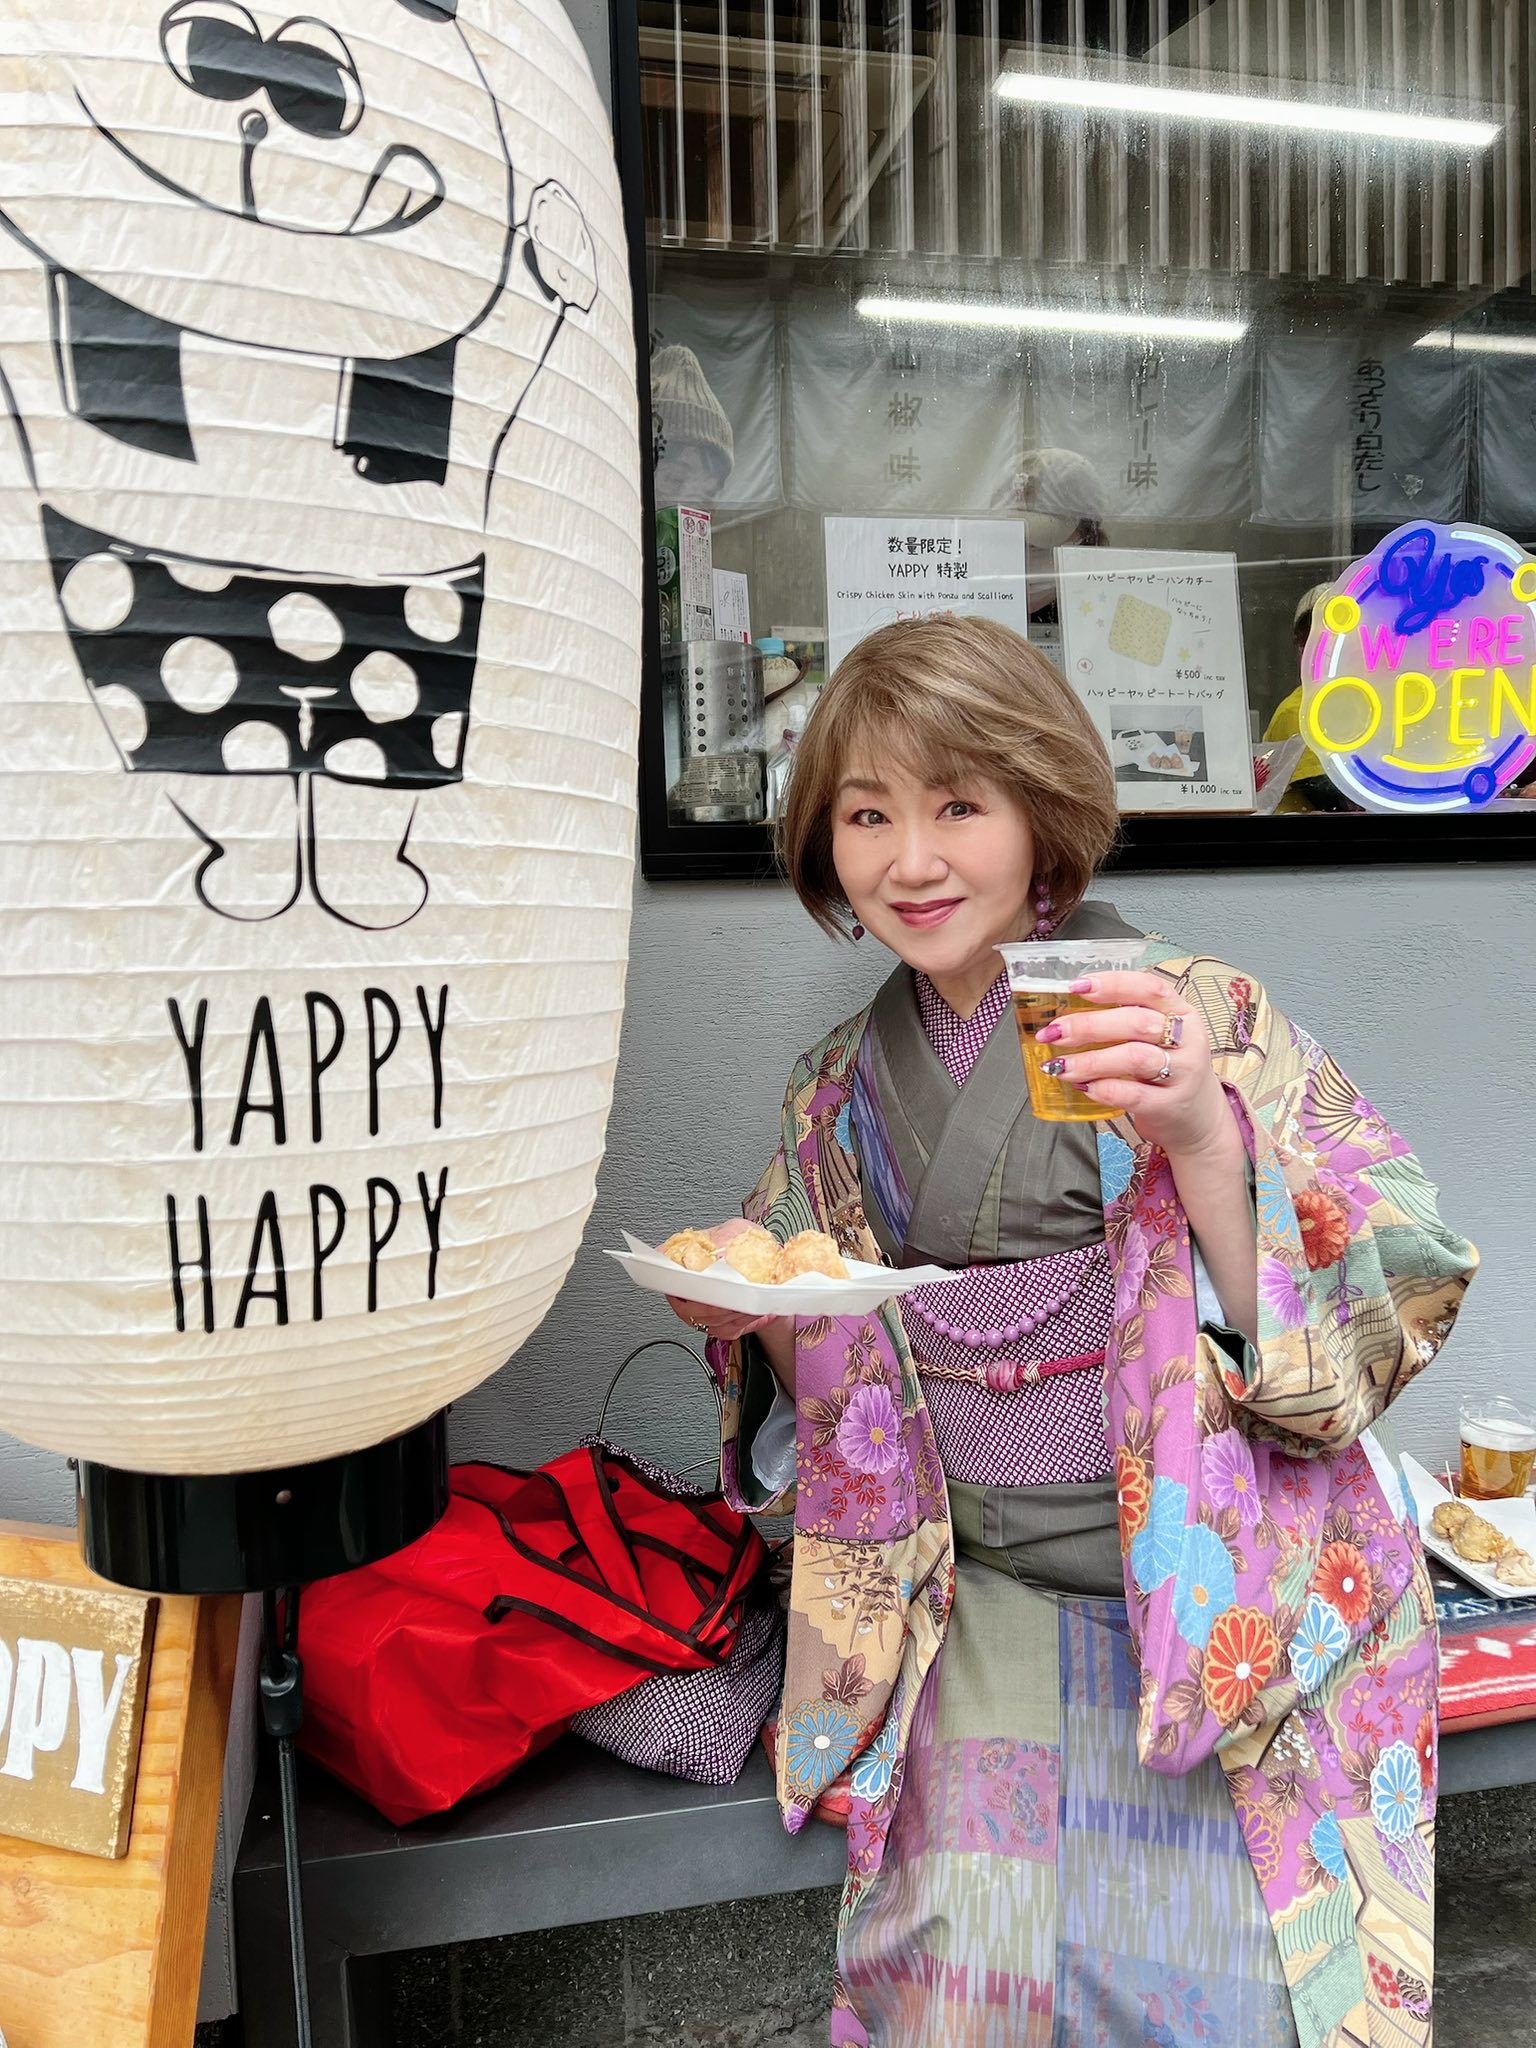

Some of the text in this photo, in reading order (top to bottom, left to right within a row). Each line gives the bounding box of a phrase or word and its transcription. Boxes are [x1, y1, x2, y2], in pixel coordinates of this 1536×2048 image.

[887, 536, 963, 556] 数量限定！
[888, 562, 969, 580] YAPPY 特製
[836, 590, 1014, 601] Crispy Chicken Skin with Ponzu and Scallions
[1175, 668, 1201, 680] ¥500
[1308, 664, 1536, 753] OPEN
[1181, 783, 1218, 795] ¥1,000
[167, 982, 451, 1153] YAPPY
[164, 1165, 450, 1335] HAPPY
